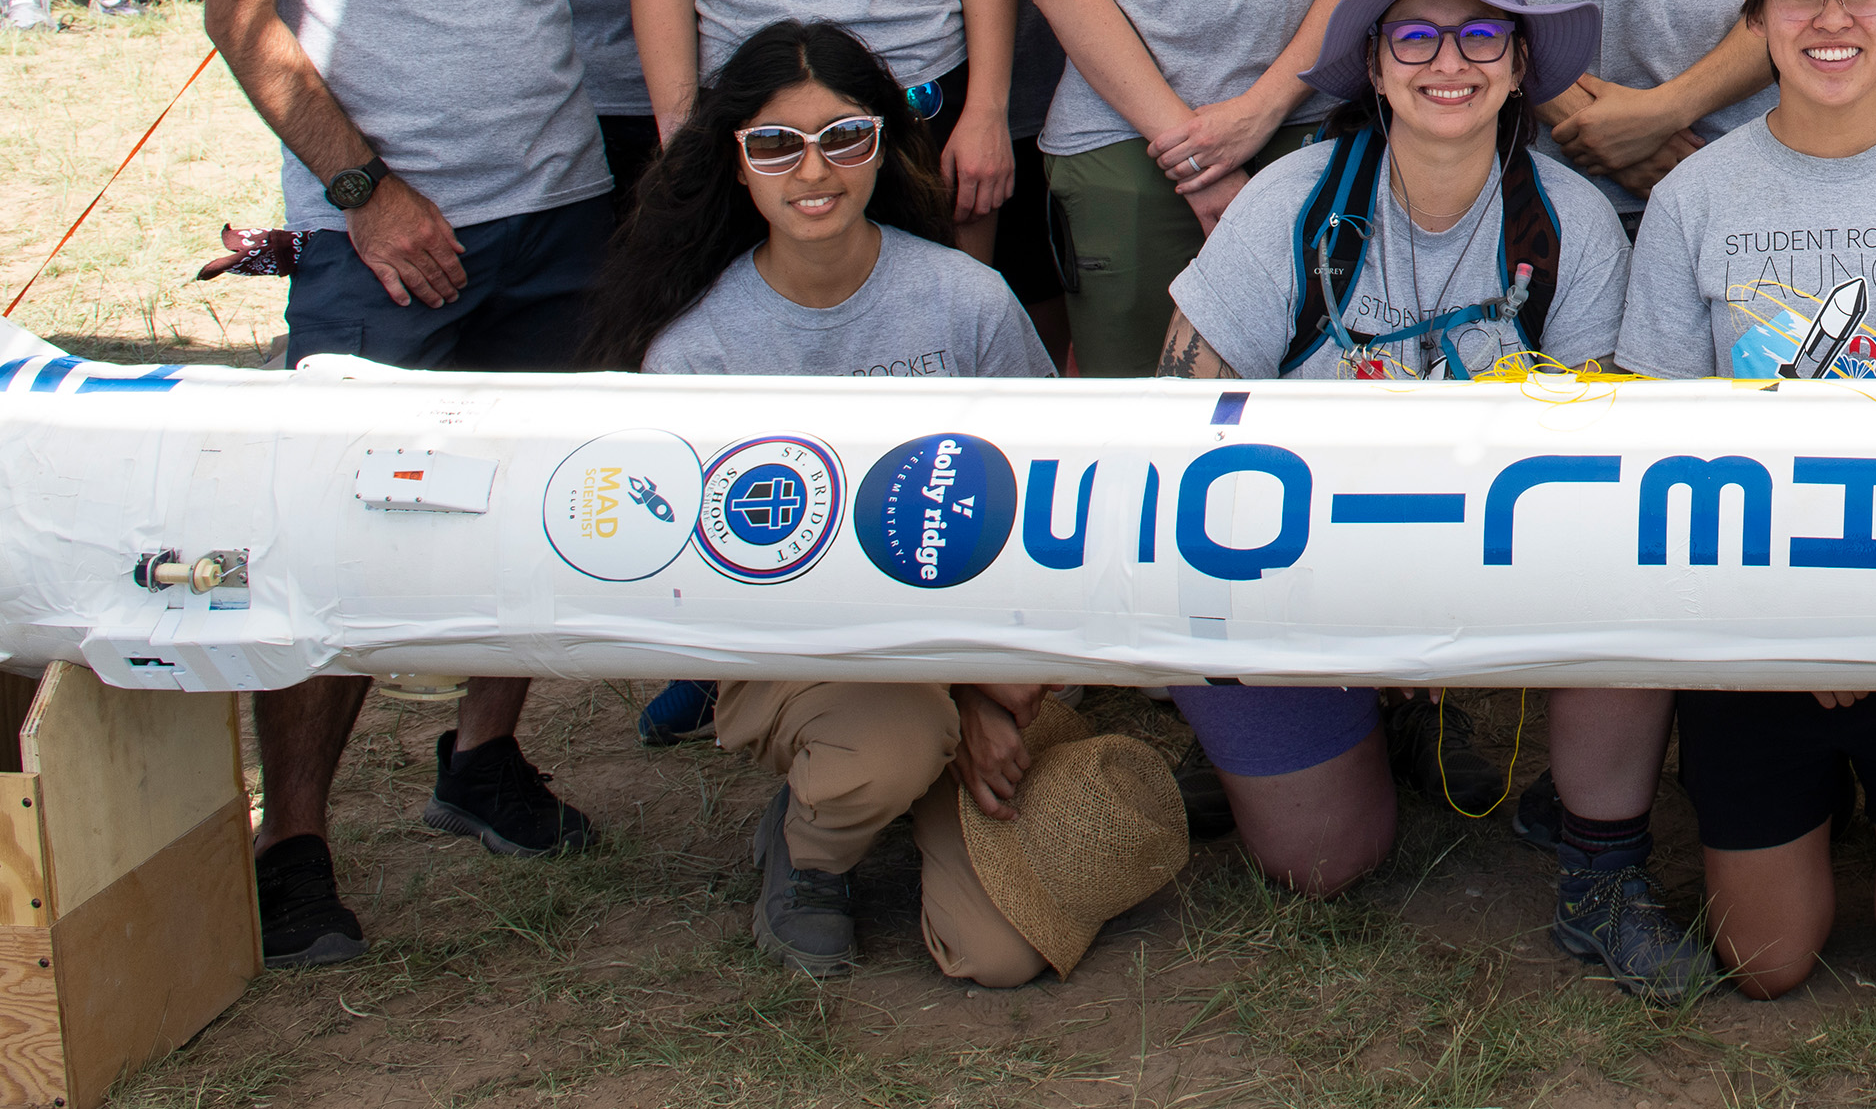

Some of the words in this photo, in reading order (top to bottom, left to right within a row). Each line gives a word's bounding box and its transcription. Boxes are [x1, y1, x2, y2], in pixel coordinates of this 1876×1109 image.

[1725, 228, 1839, 256] STUDENT
[781, 445, 808, 467] ST.
[921, 439, 963, 504] dolly
[569, 490, 577, 521] CLUB
[581, 468, 597, 540] SCIENTIST
[598, 466, 623, 538] MAD
[710, 467, 738, 545] SCHOOL
[777, 470, 827, 563] BRIDGET
[886, 455, 919, 557] ELEMENTARY
[915, 508, 948, 581] ridge
